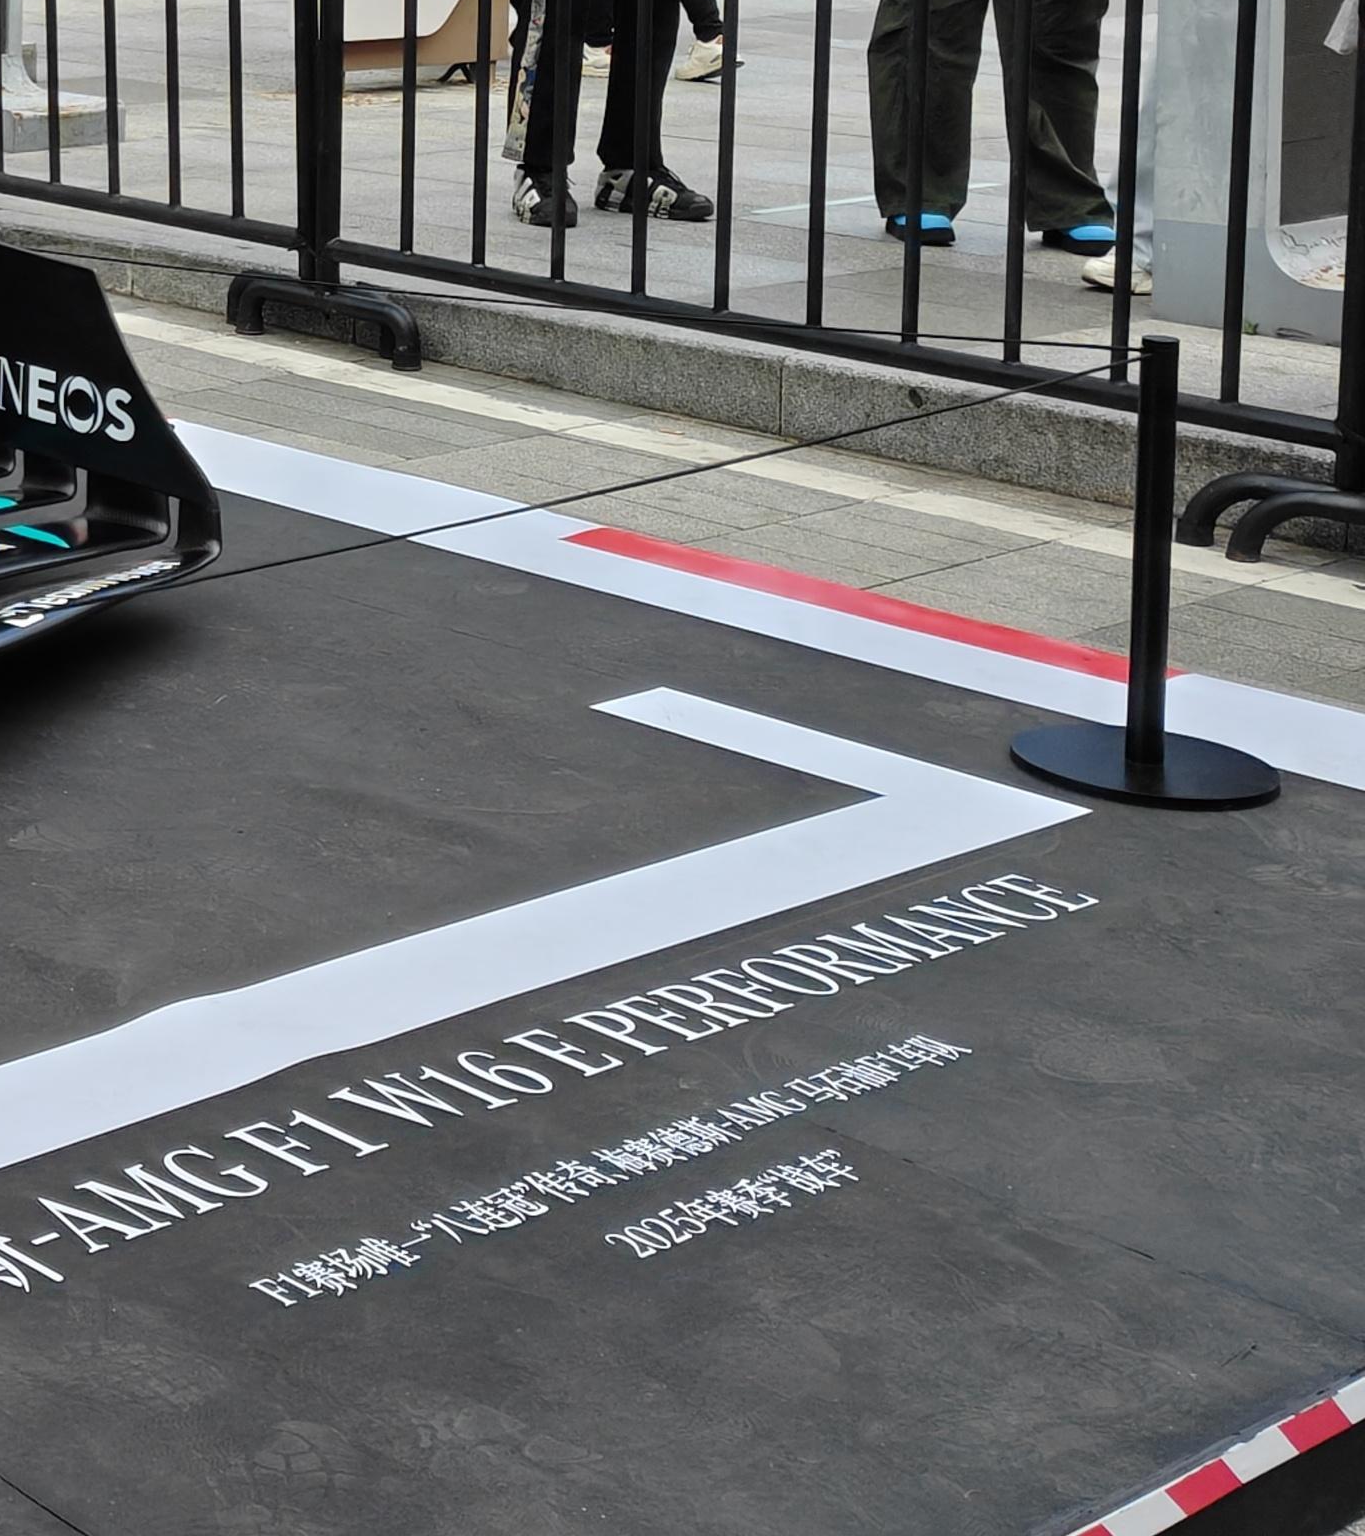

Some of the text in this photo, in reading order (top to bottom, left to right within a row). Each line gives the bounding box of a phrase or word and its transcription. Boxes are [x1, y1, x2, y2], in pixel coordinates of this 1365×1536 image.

[225, 1110, 389, 1177] F1
[327, 1050, 555, 1128] W16
[502, 1028, 624, 1077] E
[563, 873, 1101, 1057] PERFORMANCE
